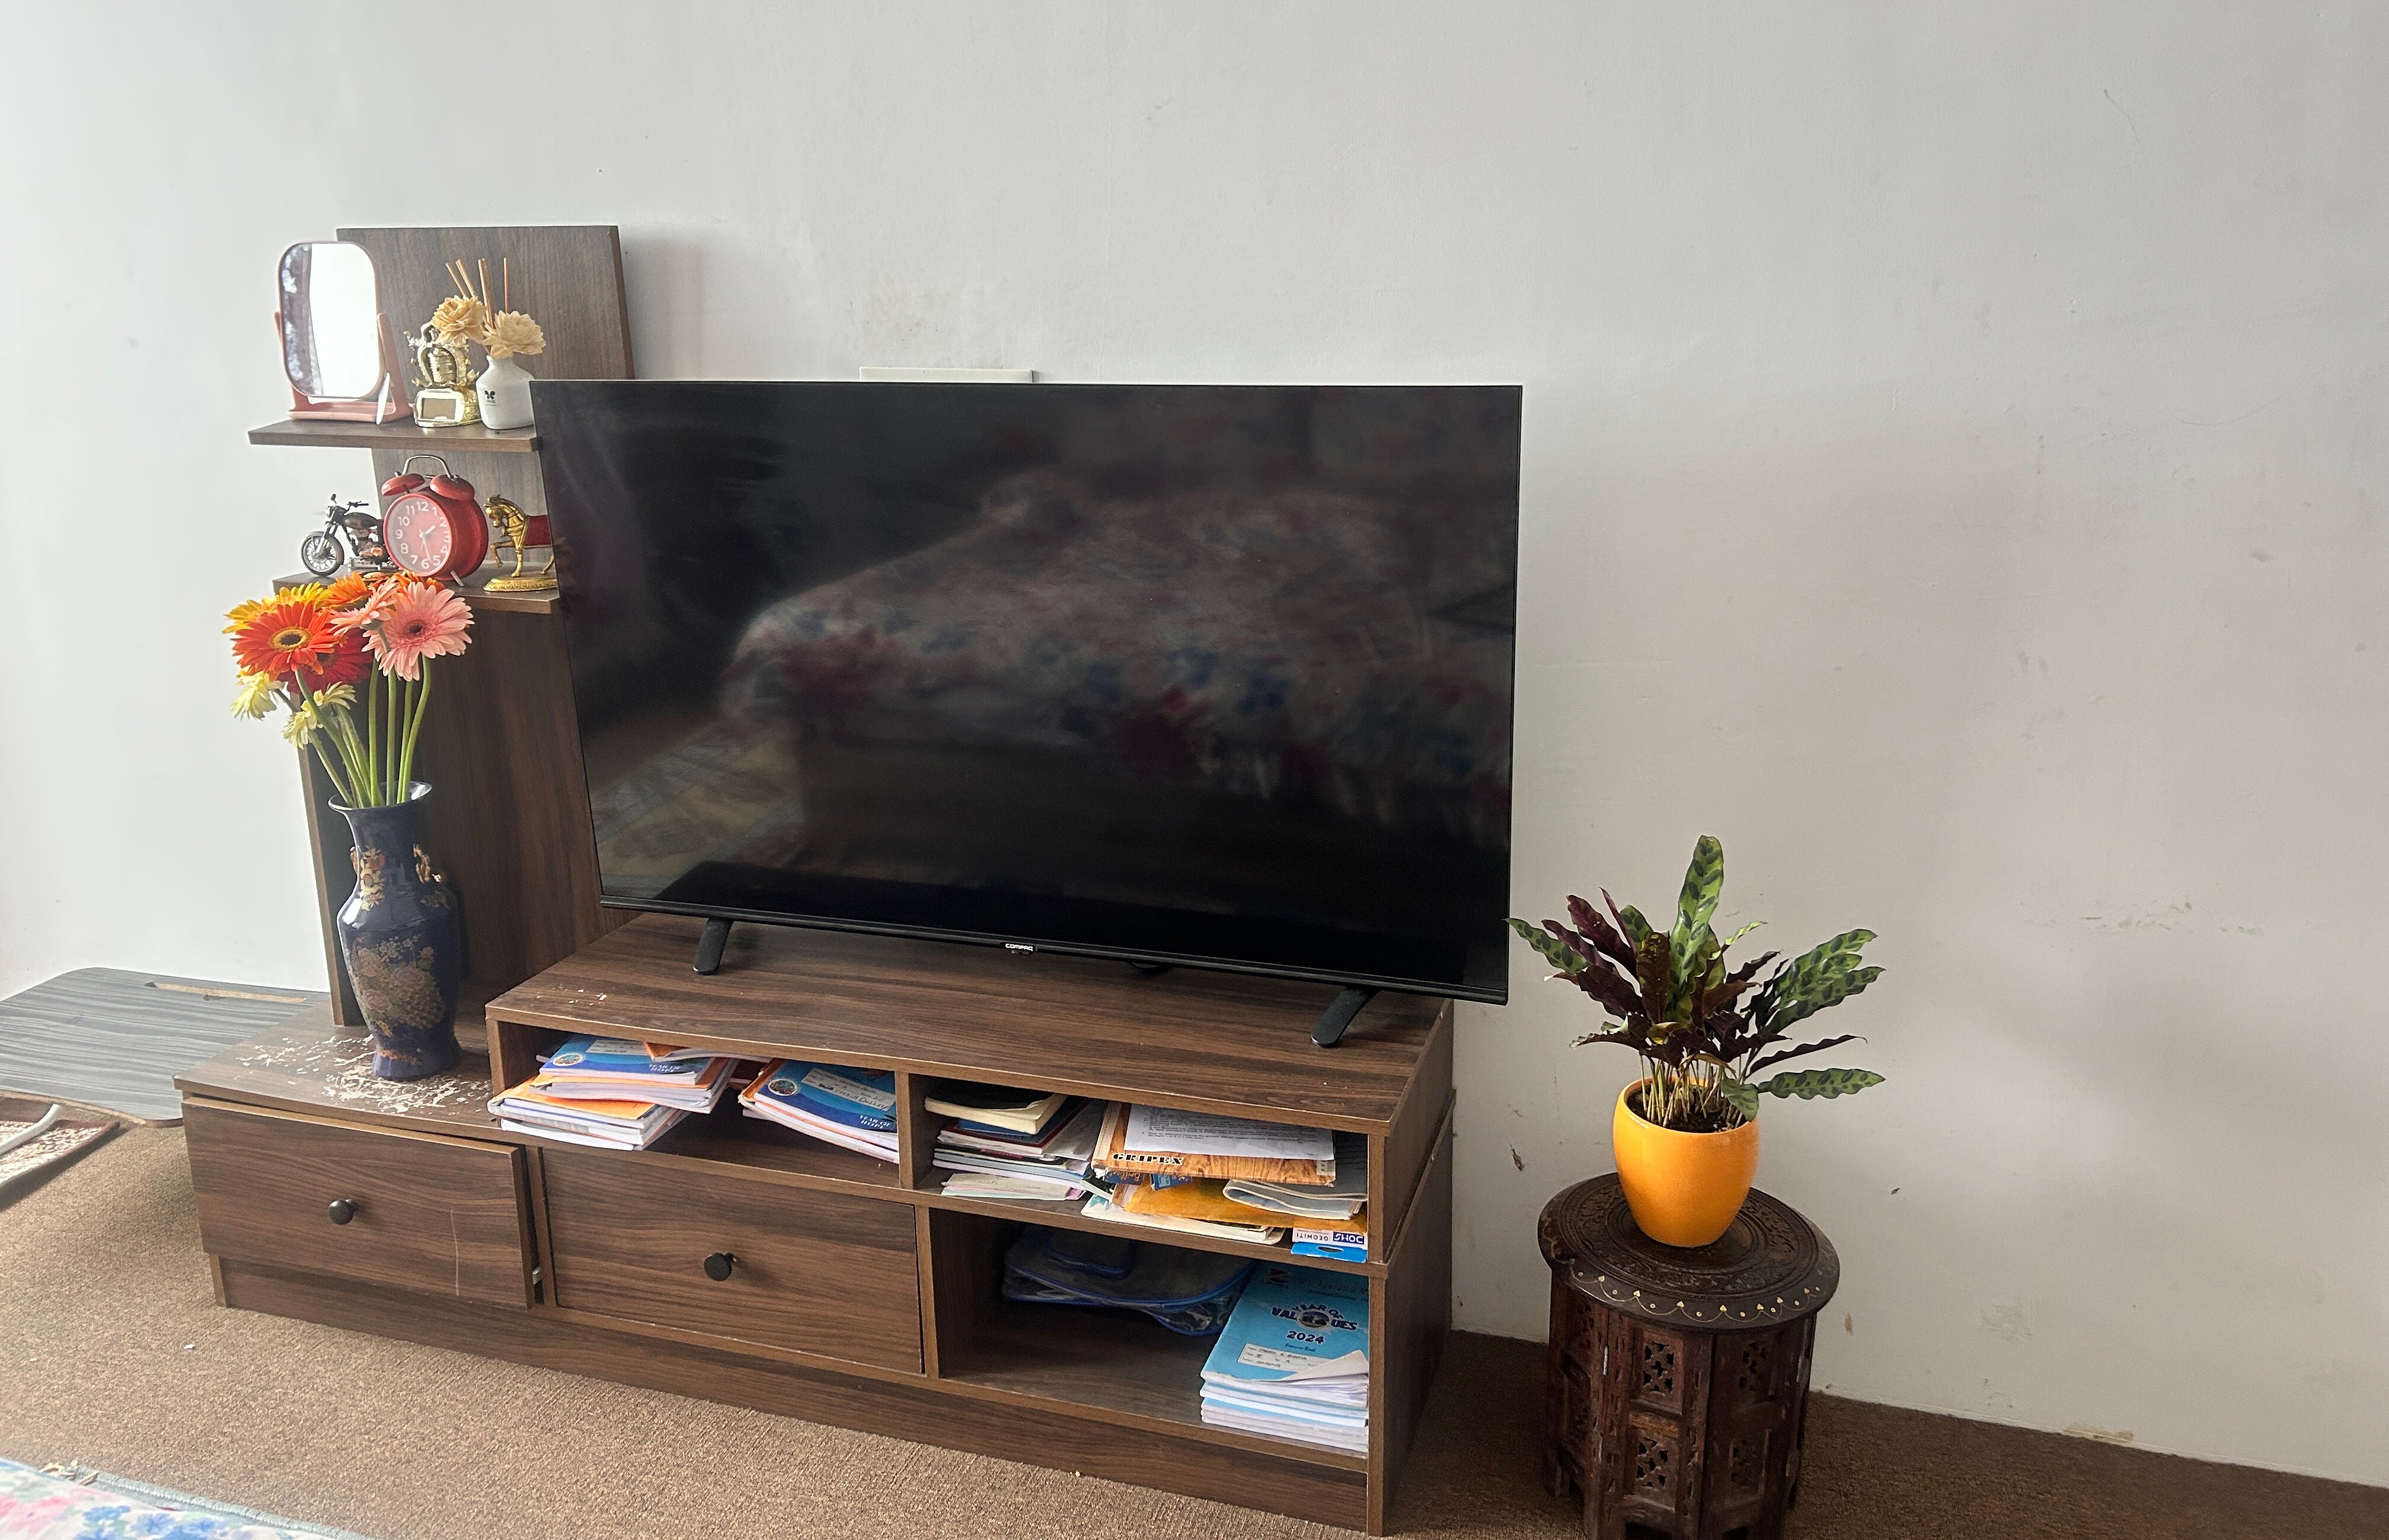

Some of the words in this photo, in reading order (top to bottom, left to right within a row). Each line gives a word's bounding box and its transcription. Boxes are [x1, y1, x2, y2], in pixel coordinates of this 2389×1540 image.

[405, 505, 415, 515] 11
[416, 501, 429, 512] 12
[432, 506, 437, 517] 1
[398, 516, 410, 526] 10
[439, 517, 448, 528] 2
[395, 529, 403, 539] 9
[443, 531, 450, 542] 3
[400, 543, 408, 554] 8
[440, 545, 448, 554] 4
[411, 555, 418, 565] 7
[421, 558, 430, 569] 6
[433, 555, 440, 566] 5
[1005, 943, 1033, 951] COMPAQ
[1112, 1153, 1184, 1165] GRIPEX
[1334, 1233, 1363, 1244] DOMS
[1292, 1304, 1327, 1312] YEAR
[1328, 1309, 1344, 1319] OF
[1286, 1331, 1324, 1344] 2024
